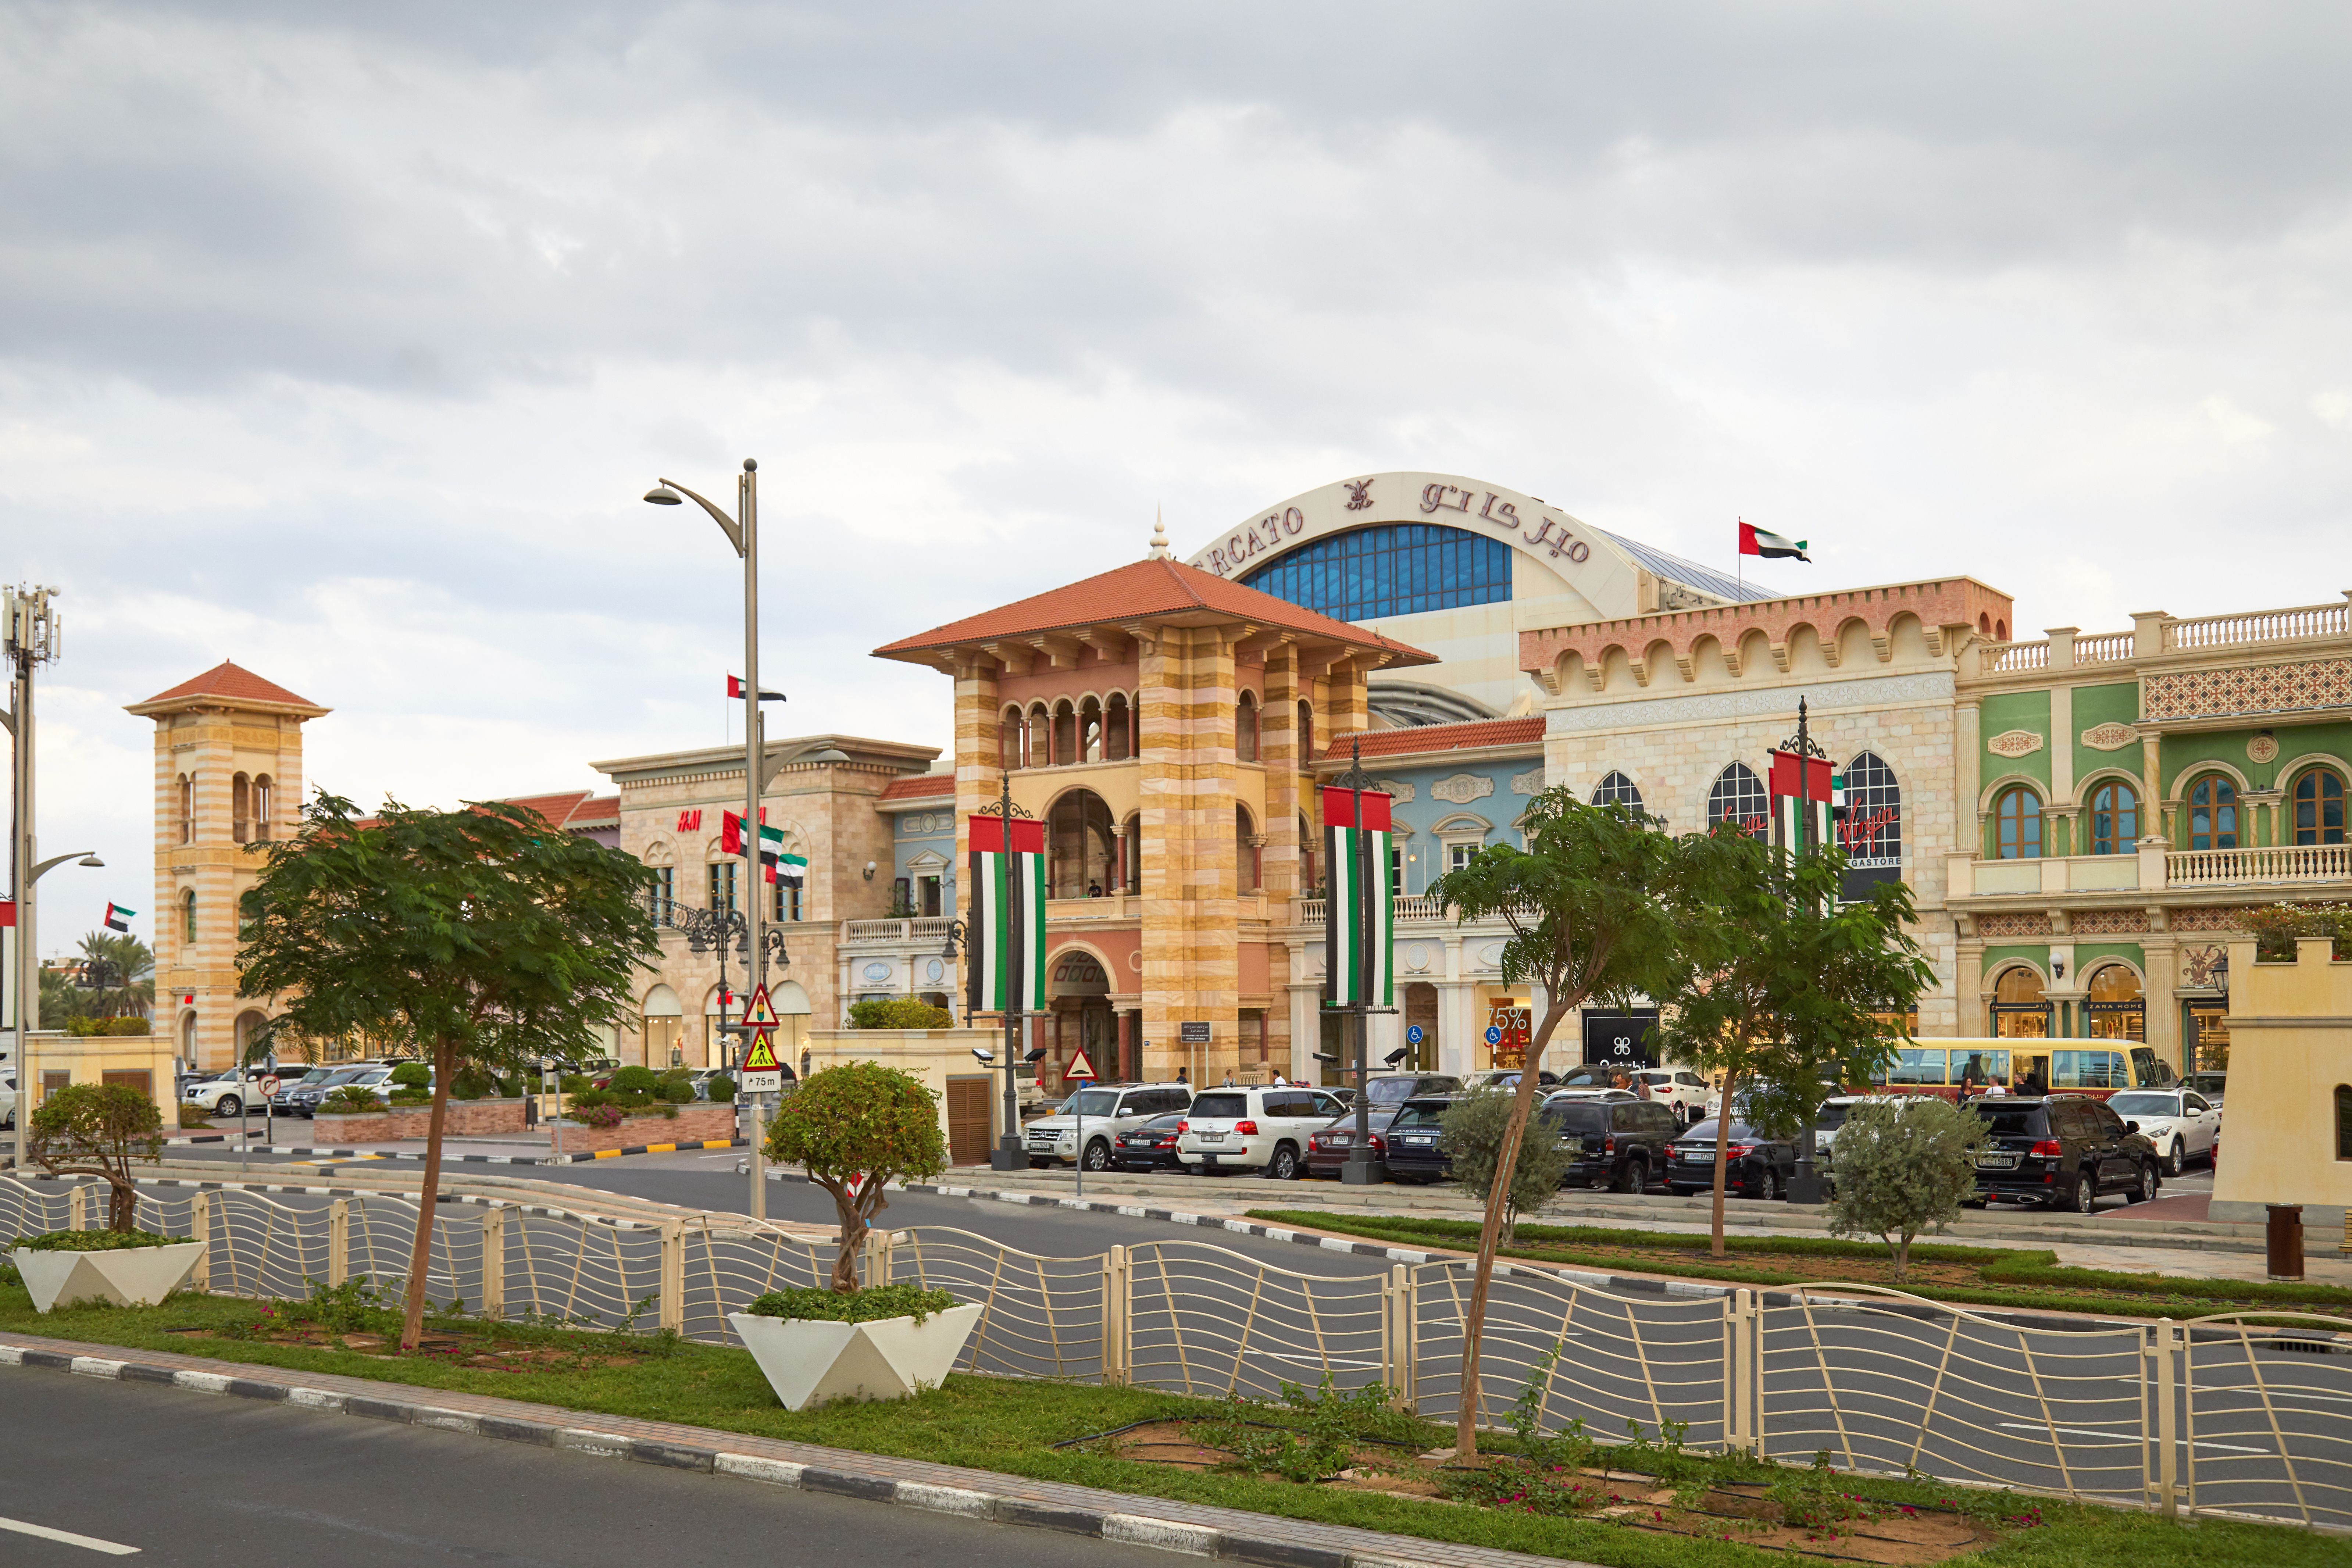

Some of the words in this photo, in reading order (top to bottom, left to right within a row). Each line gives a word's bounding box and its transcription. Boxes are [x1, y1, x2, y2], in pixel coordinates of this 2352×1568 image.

[677, 809, 701, 832] H&M
[1837, 797, 1898, 853] Virgin
[1483, 1007, 1527, 1029] 75%
